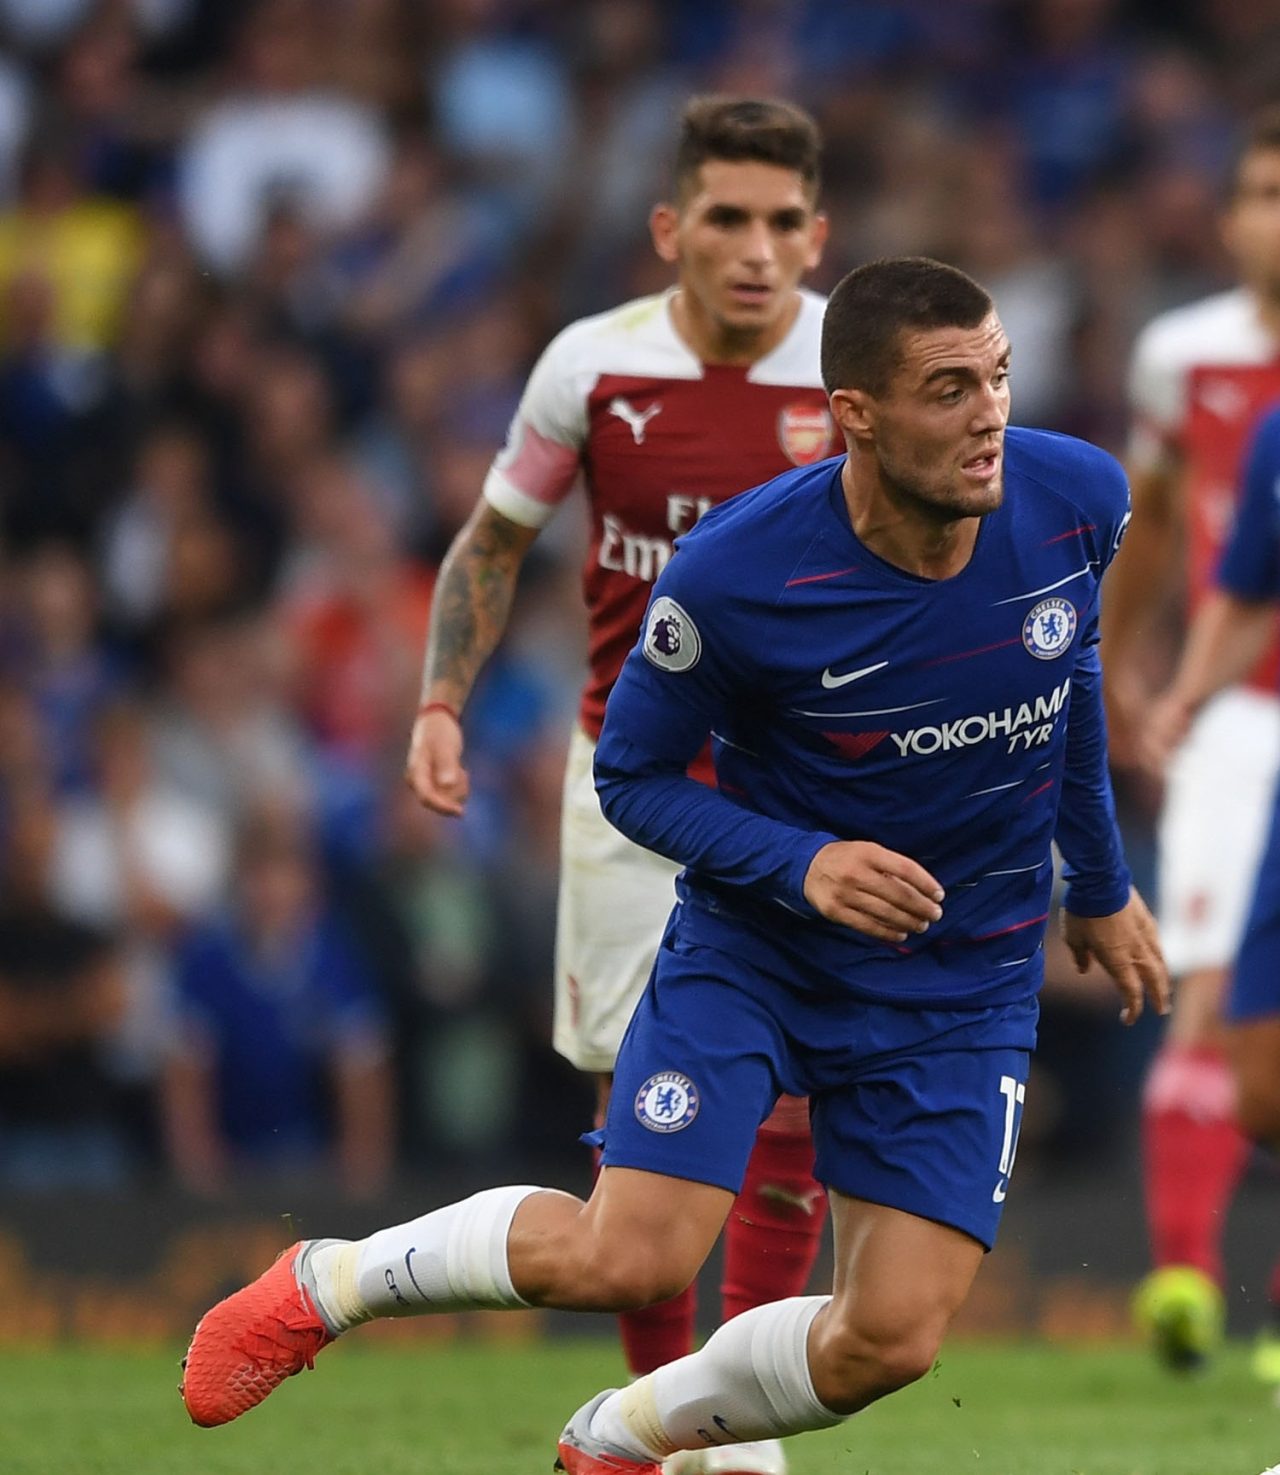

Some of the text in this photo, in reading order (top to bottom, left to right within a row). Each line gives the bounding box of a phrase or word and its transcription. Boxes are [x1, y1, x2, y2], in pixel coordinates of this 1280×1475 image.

[1030, 600, 1066, 619] CHELSEA
[890, 677, 1070, 756] YOKOHAMA
[1007, 716, 1060, 754] TYR
